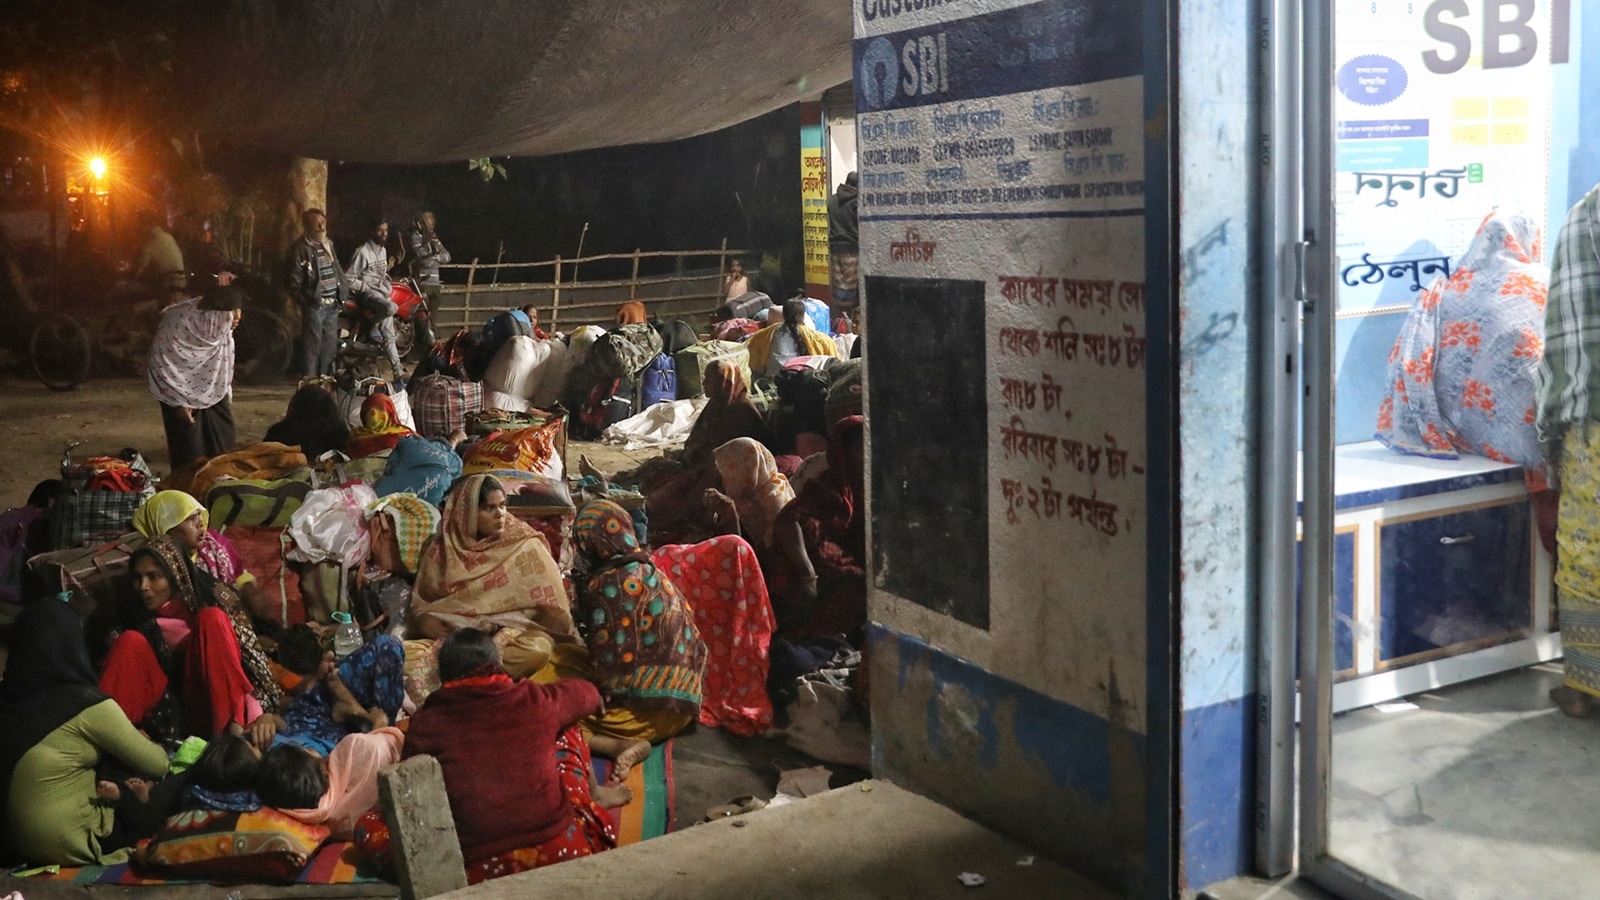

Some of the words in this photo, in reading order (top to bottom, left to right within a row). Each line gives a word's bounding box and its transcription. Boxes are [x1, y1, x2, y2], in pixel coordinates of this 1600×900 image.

[1421, 0, 1570, 75] SBI
[902, 32, 950, 97] SBI
[1063, 277, 1114, 316] সময়
[1341, 252, 1451, 292] ঠেলুন
[1000, 326, 1040, 358] থেকে
[1042, 316, 1079, 361] শনি
[999, 415, 1058, 471] রবিবার
